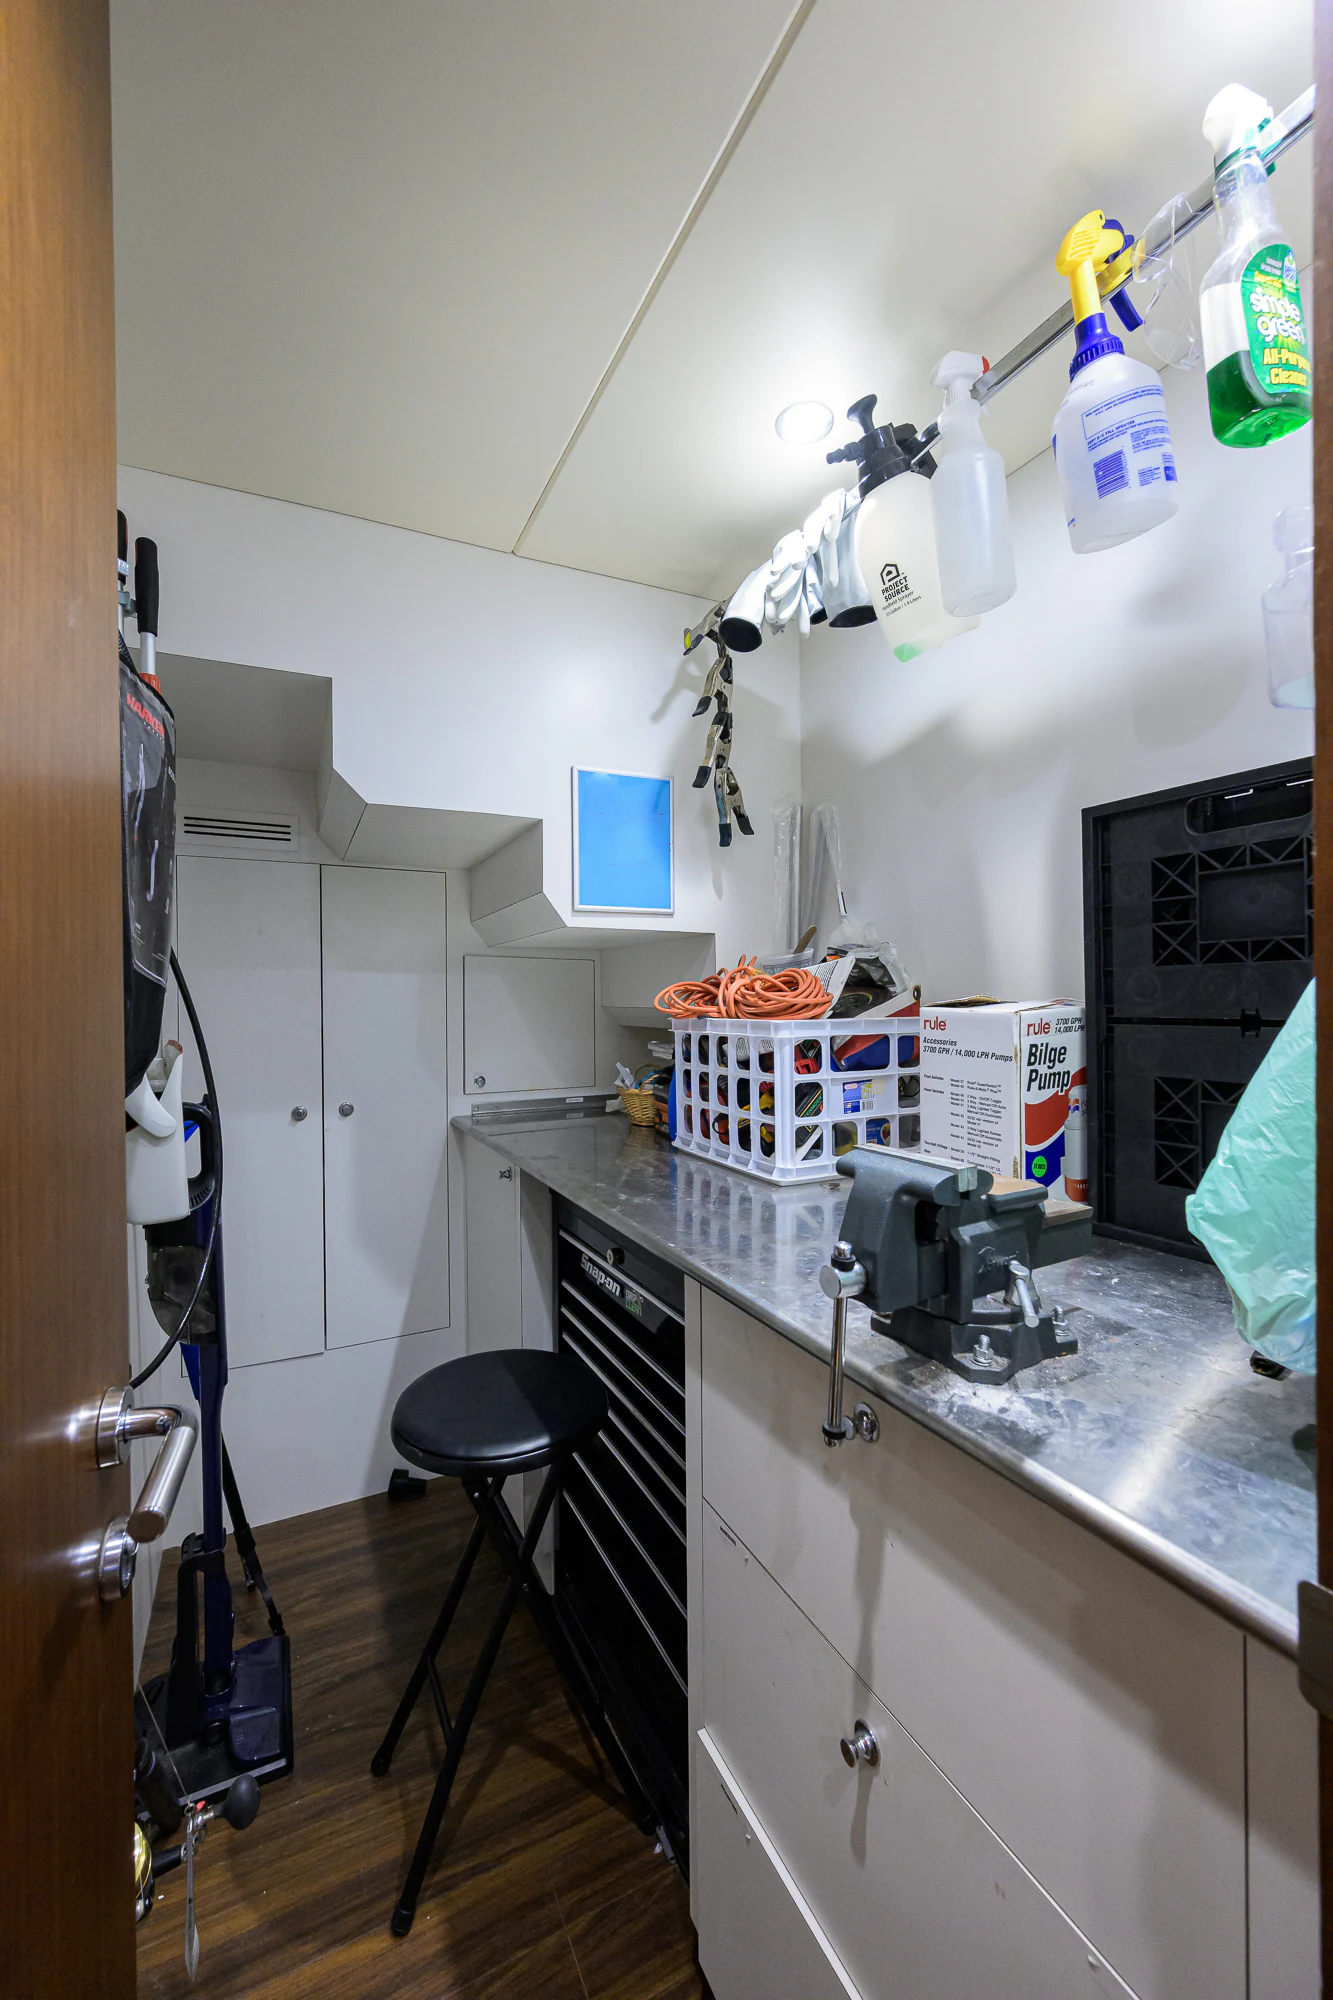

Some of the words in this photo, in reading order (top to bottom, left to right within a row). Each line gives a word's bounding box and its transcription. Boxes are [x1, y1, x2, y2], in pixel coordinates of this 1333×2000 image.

[1250, 287, 1300, 322] simple
[1256, 315, 1305, 345] green
[882, 576, 908, 595] PROJECT
[885, 584, 909, 602] SOURCE
[898, 591, 913, 602] Sprayer
[924, 1016, 946, 1031] rule
[1027, 1018, 1051, 1036] rule
[923, 1037, 957, 1046] Accessories
[956, 1049, 975, 1057] 14,000
[977, 1051, 989, 1059] LPH
[990, 1053, 1013, 1062] Pumps
[1027, 1043, 1067, 1069] Bilge
[1027, 1069, 1070, 1093] Pump
[581, 1252, 620, 1297] Snap-on
